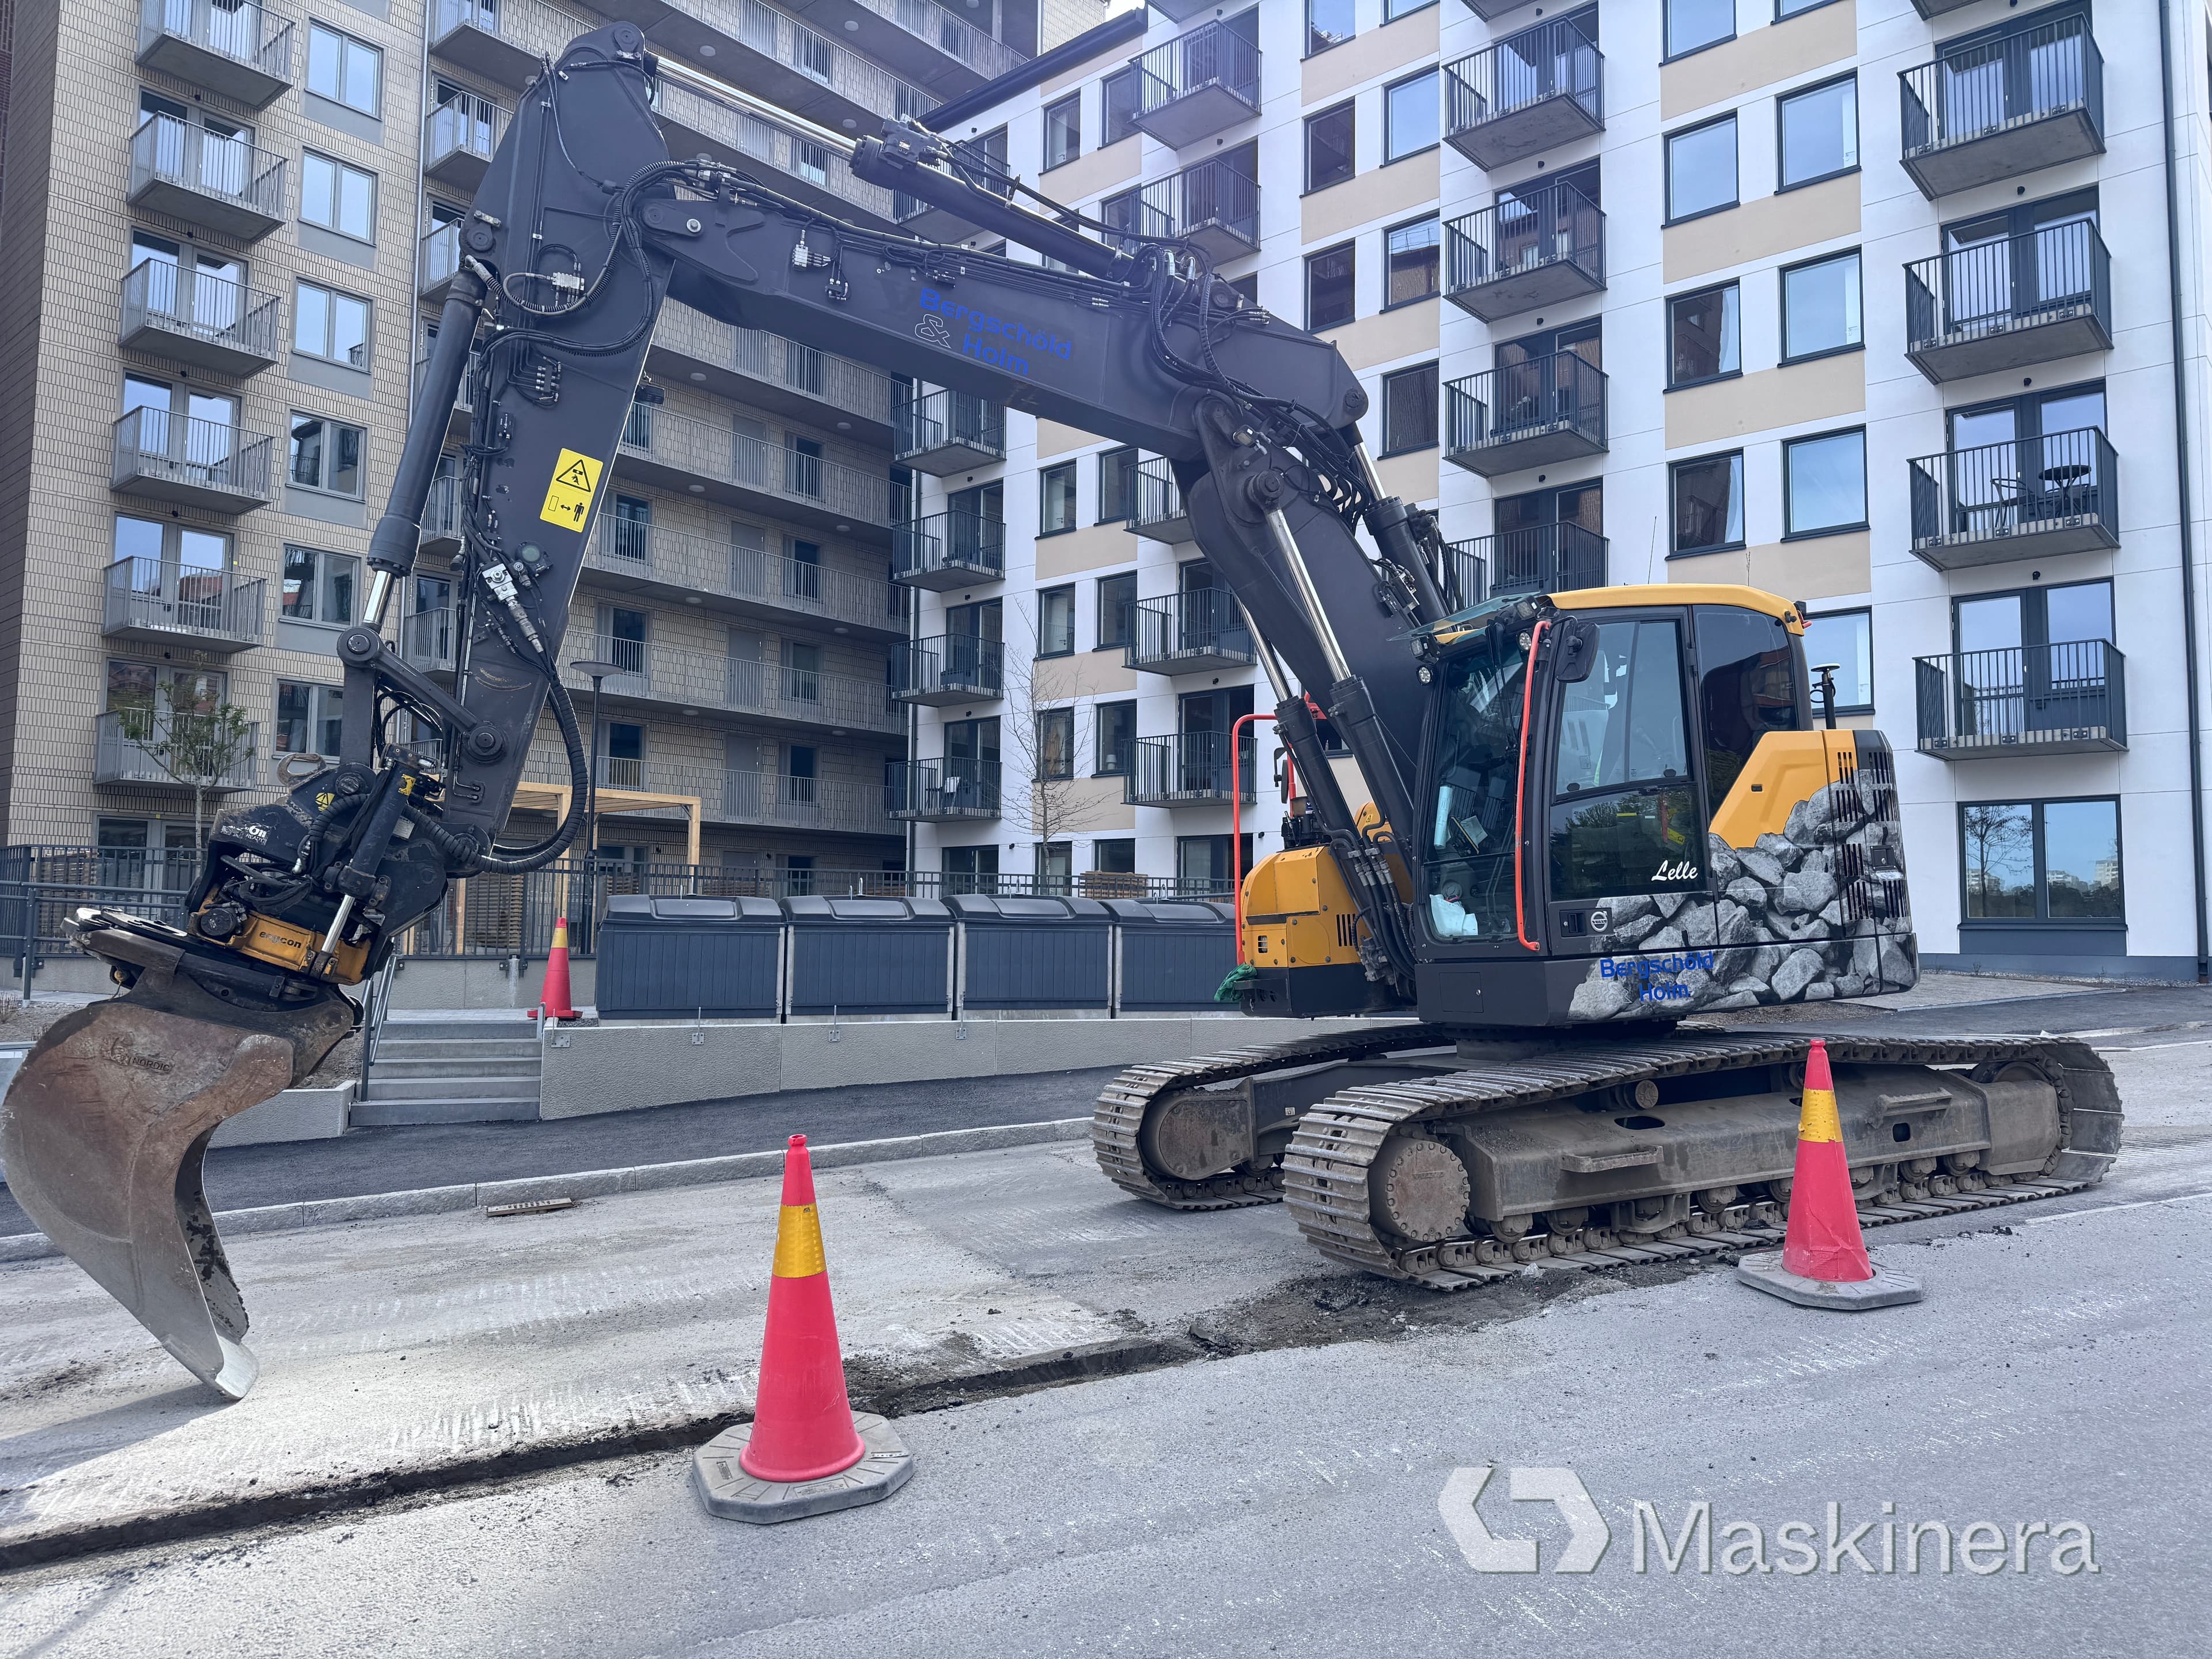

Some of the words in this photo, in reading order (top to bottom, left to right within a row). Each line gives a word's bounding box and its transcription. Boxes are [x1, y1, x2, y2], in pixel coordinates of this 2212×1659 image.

[919, 287, 1072, 360] Bergschöld
[914, 313, 952, 349] &
[962, 332, 1029, 376] Holm
[1651, 859, 1698, 881] Lelle
[1600, 951, 1714, 980] Bergschöld
[1639, 982, 1690, 1002] Holm
[132, 1057, 170, 1071] NORDIC
